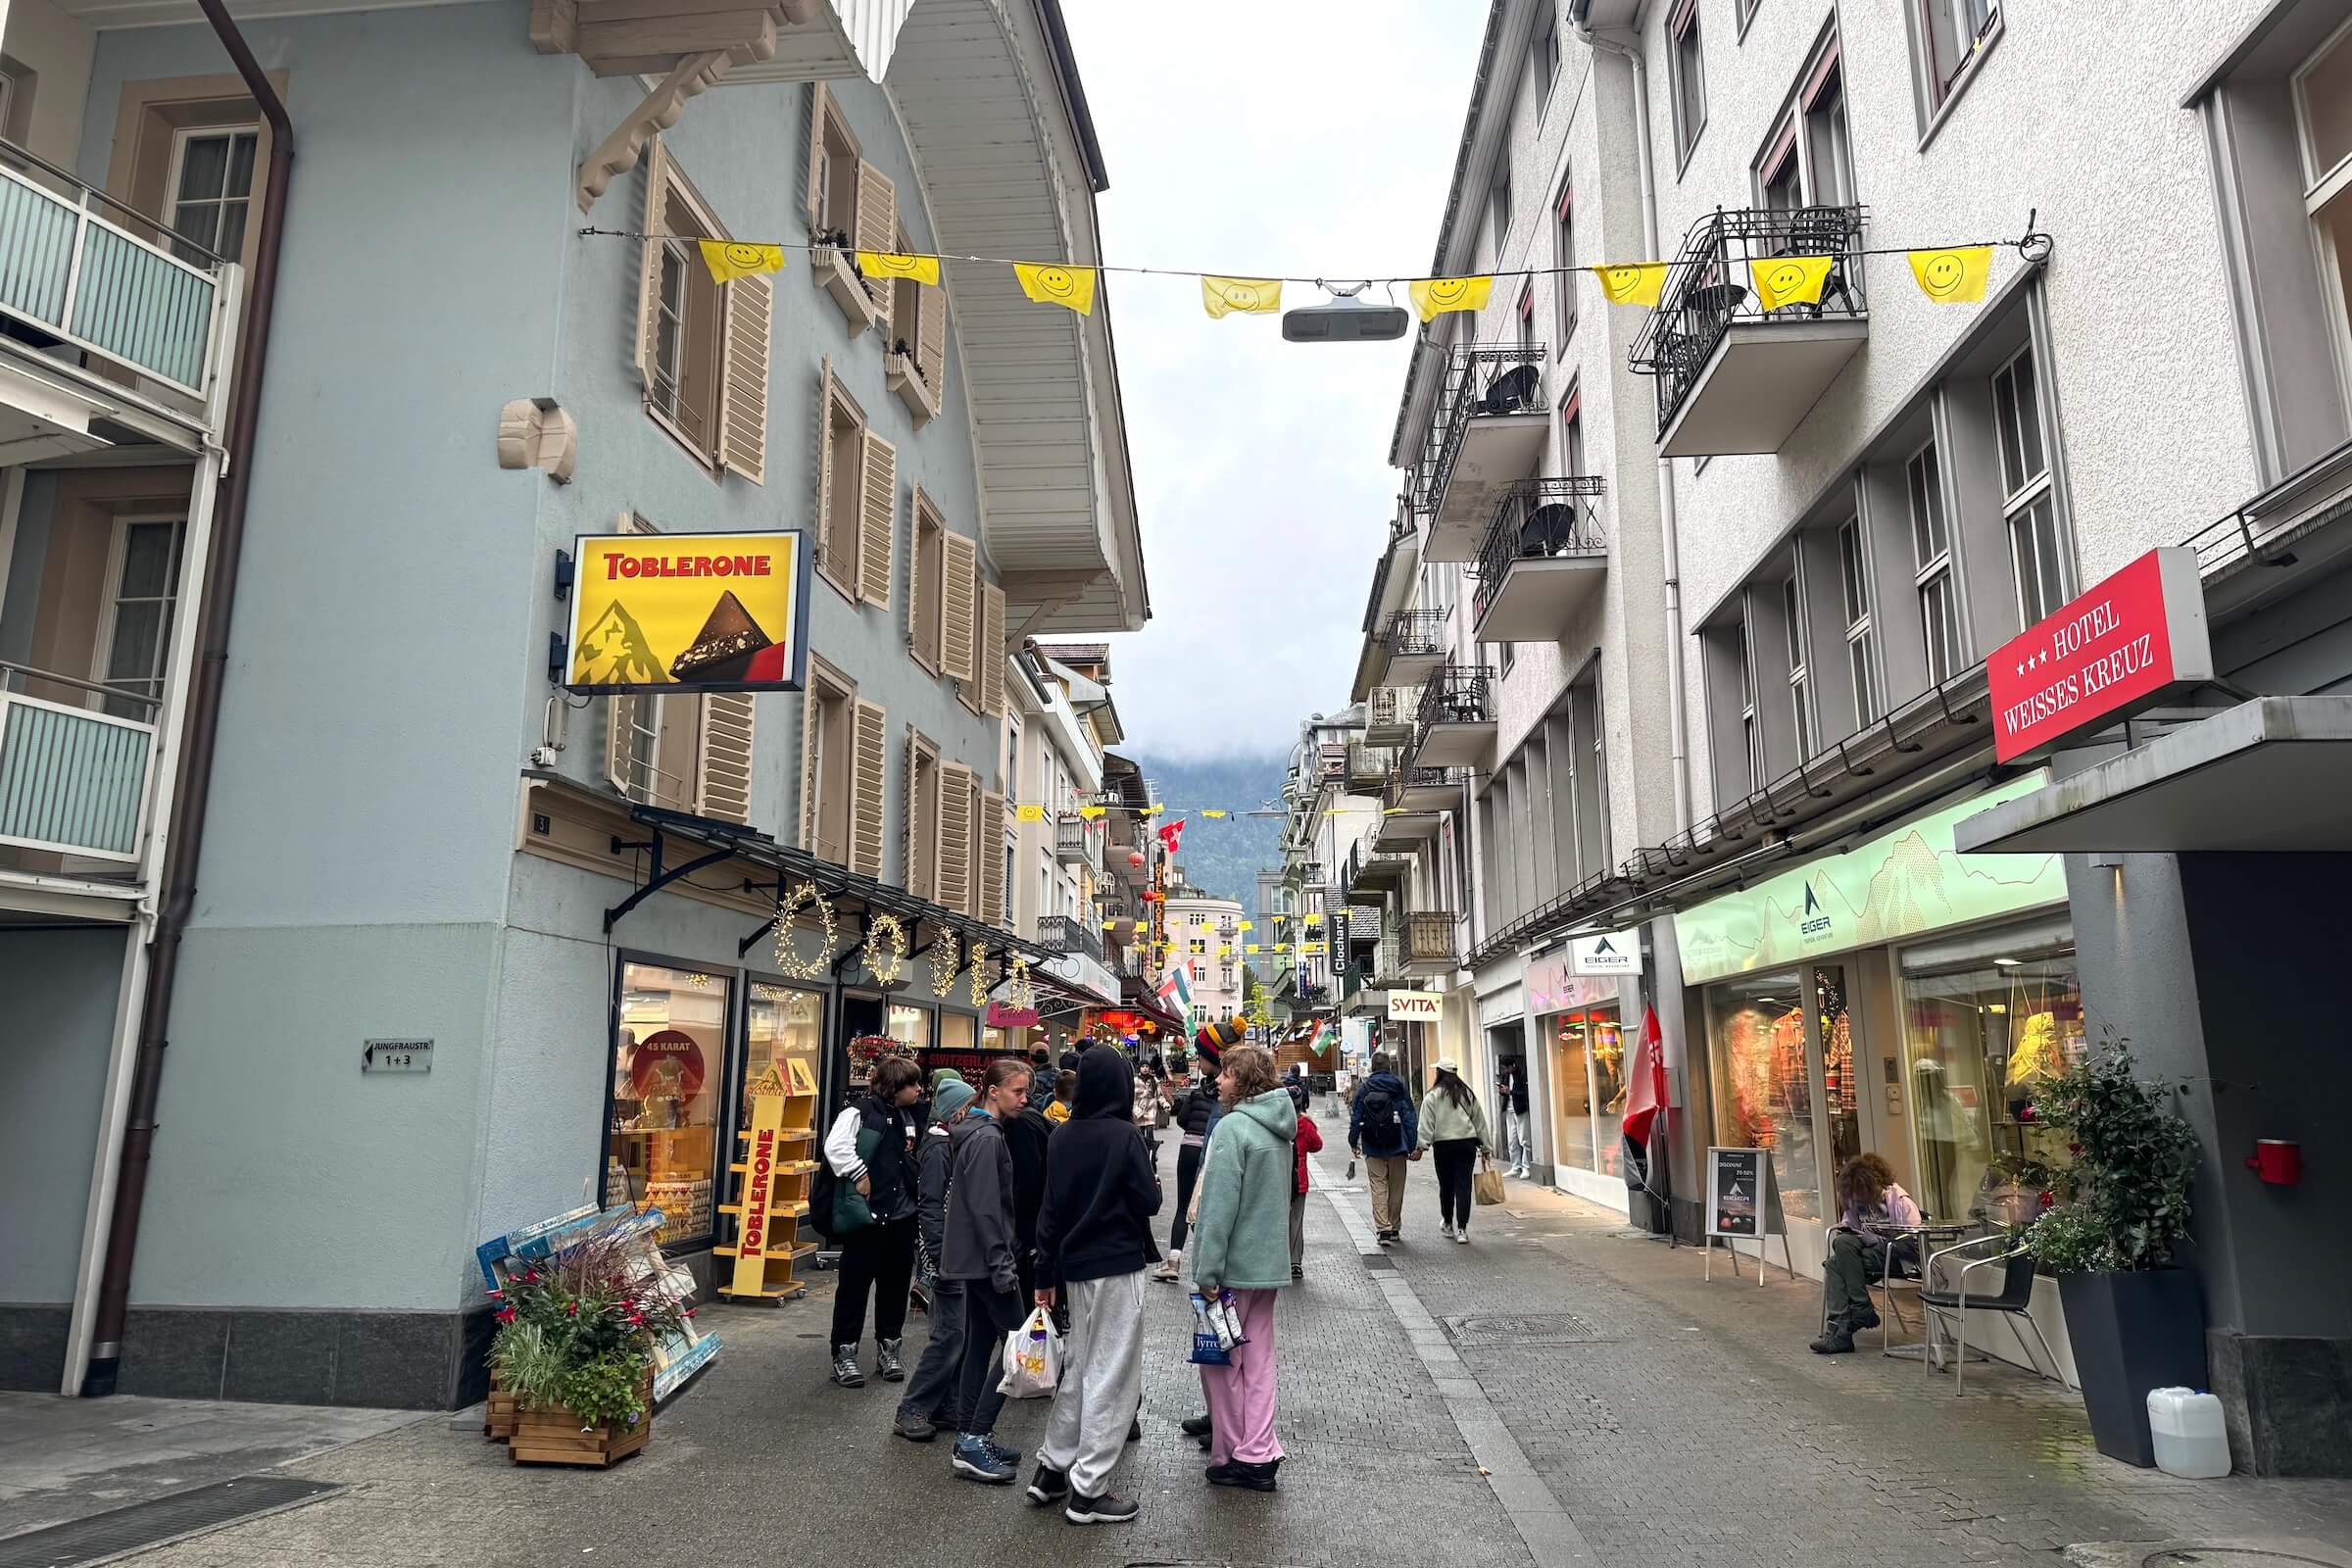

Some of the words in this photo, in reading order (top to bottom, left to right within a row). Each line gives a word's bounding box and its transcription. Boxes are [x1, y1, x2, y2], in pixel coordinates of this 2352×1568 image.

[604, 553, 771, 580] TOBLERONE
[2053, 600, 2120, 662] HOTEL
[2004, 674, 2080, 737] WEISSES
[2082, 633, 2154, 697] KREUZ
[1800, 916, 1831, 934] EIGER
[1334, 916, 1346, 971] Clochard
[1392, 998, 1436, 1012] SVITA
[374, 1042, 431, 1051] JUNGFRAUSTR.
[661, 1042, 691, 1052] KARAT
[385, 1054, 391, 1065] 1
[403, 1054, 411, 1065] 3
[741, 1128, 774, 1260] TOBLERONE
